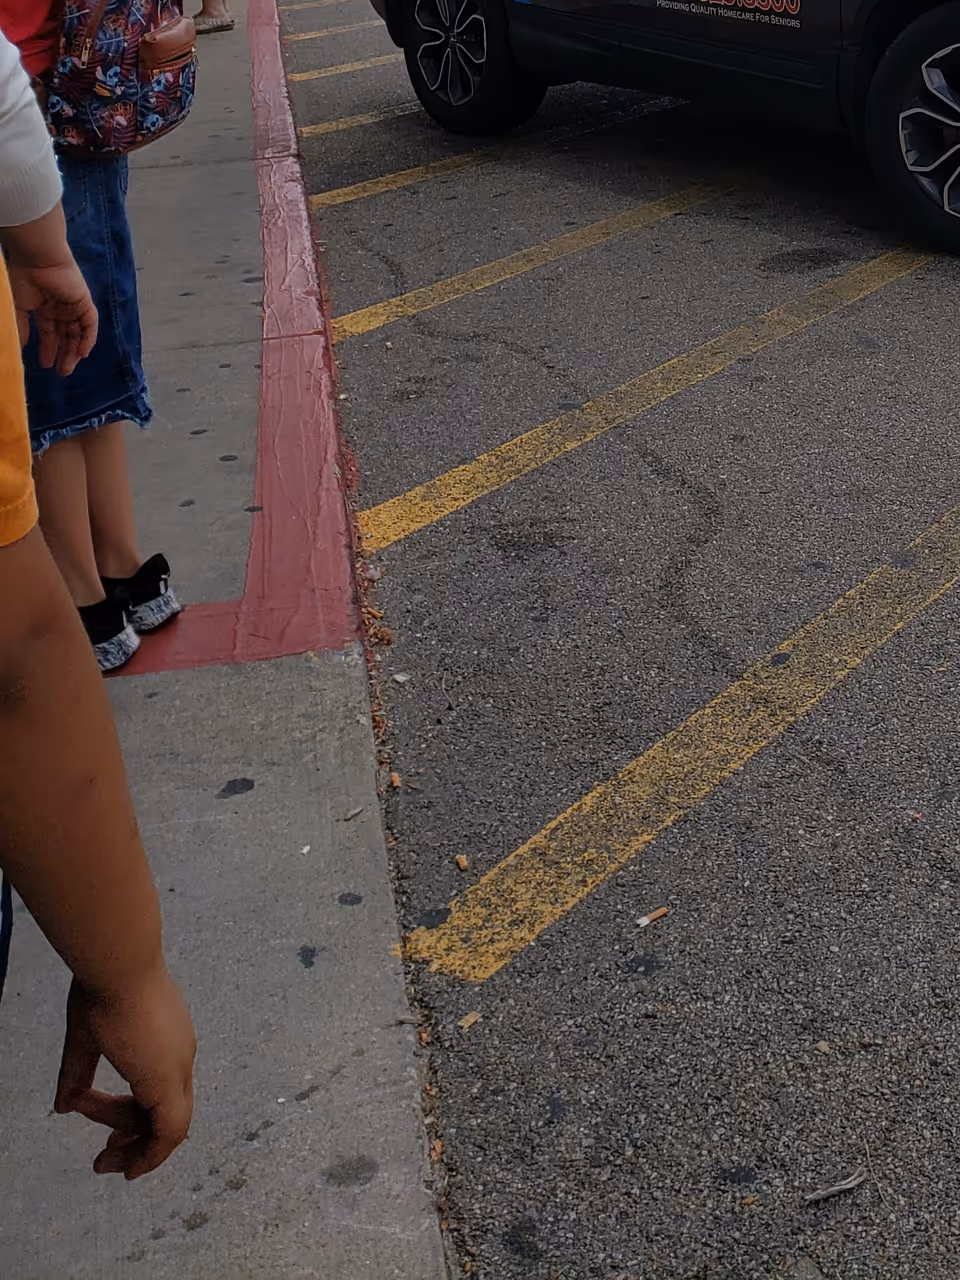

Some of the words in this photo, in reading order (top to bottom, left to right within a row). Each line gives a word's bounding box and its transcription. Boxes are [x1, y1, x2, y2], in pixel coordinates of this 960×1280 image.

[690, 3, 717, 16] QUALITY
[718, 7, 755, 21] HOMECARE
[755, 12, 770, 24] FOR
[770, 15, 801, 28] SENIORS
